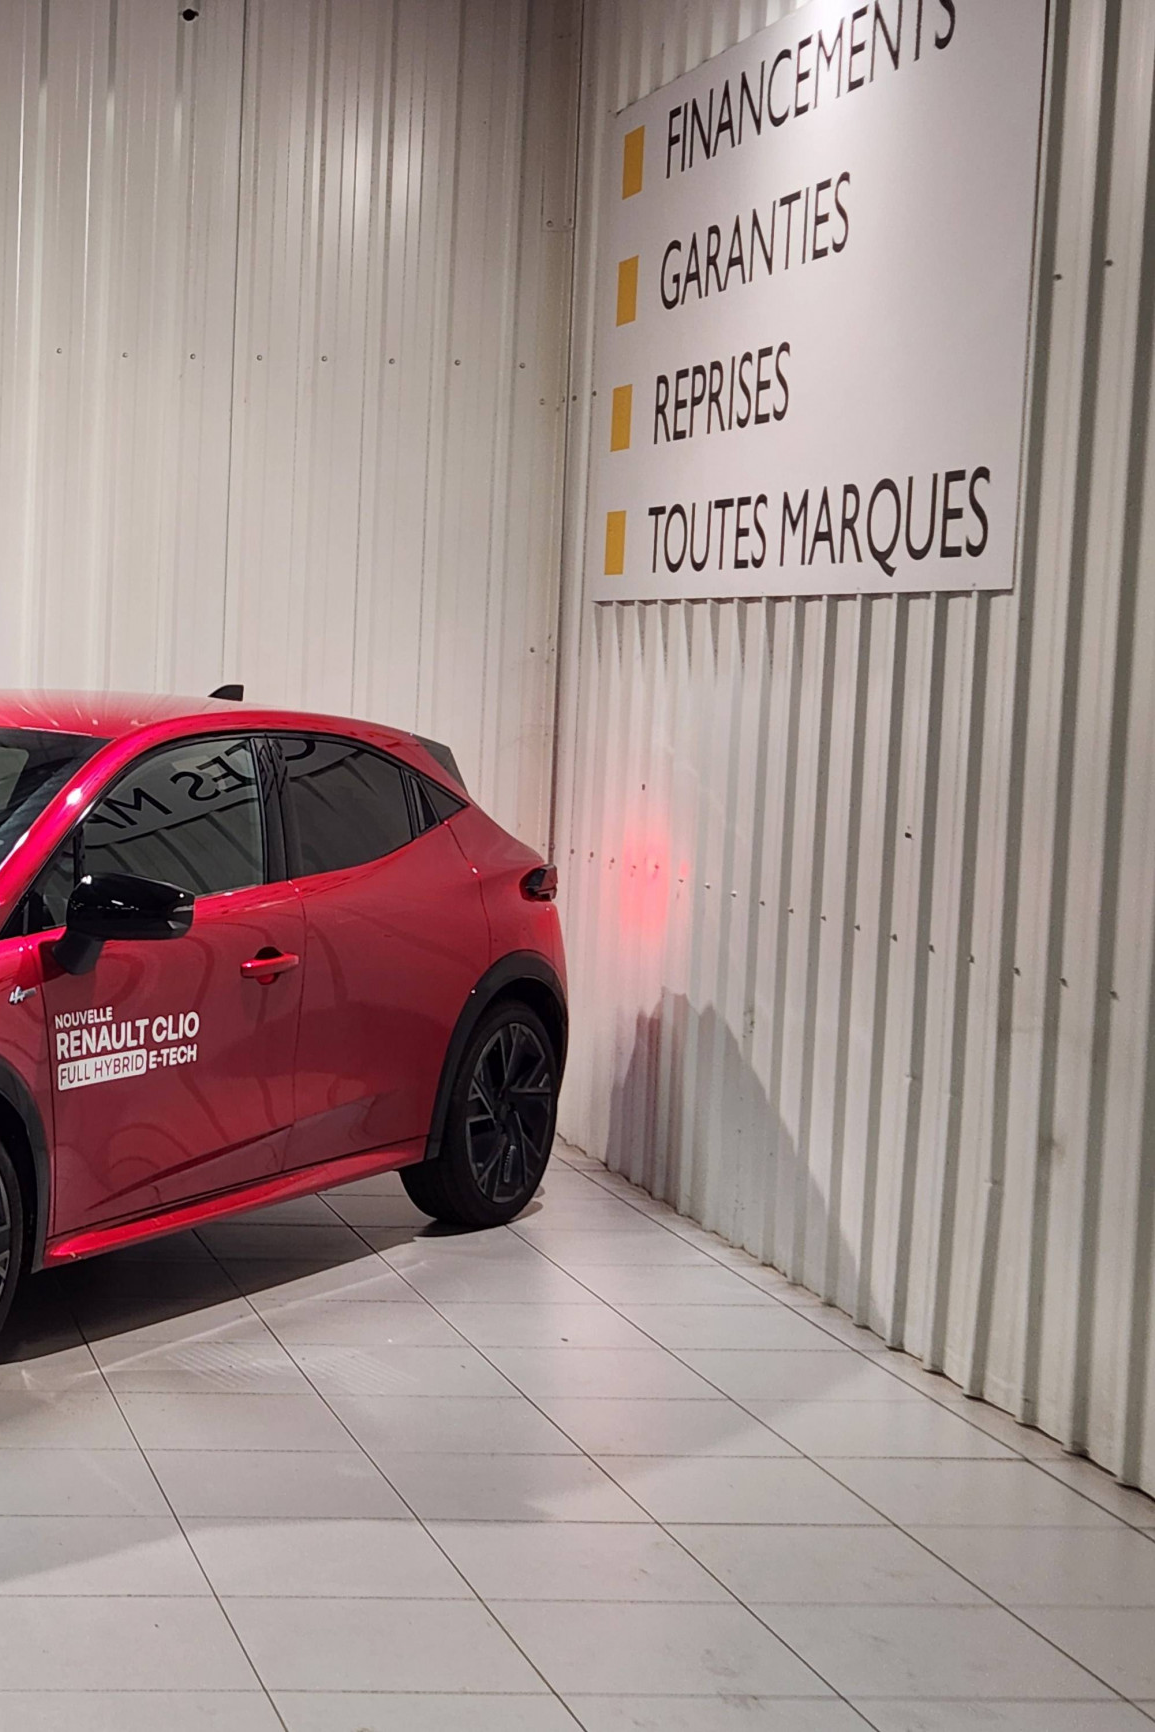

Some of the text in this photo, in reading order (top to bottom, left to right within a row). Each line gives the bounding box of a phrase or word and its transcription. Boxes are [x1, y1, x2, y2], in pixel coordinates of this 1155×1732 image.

[660, 171, 850, 309] GARANTIES
[653, 342, 790, 444] REPRISES
[648, 466, 990, 577] TOUTES MARQUES
[54, 1006, 113, 1029] NOUVELLE
[56, 1011, 199, 1060] RENAULT CLIO
[60, 1044, 197, 1086] FULL HYBRID E-TECH
